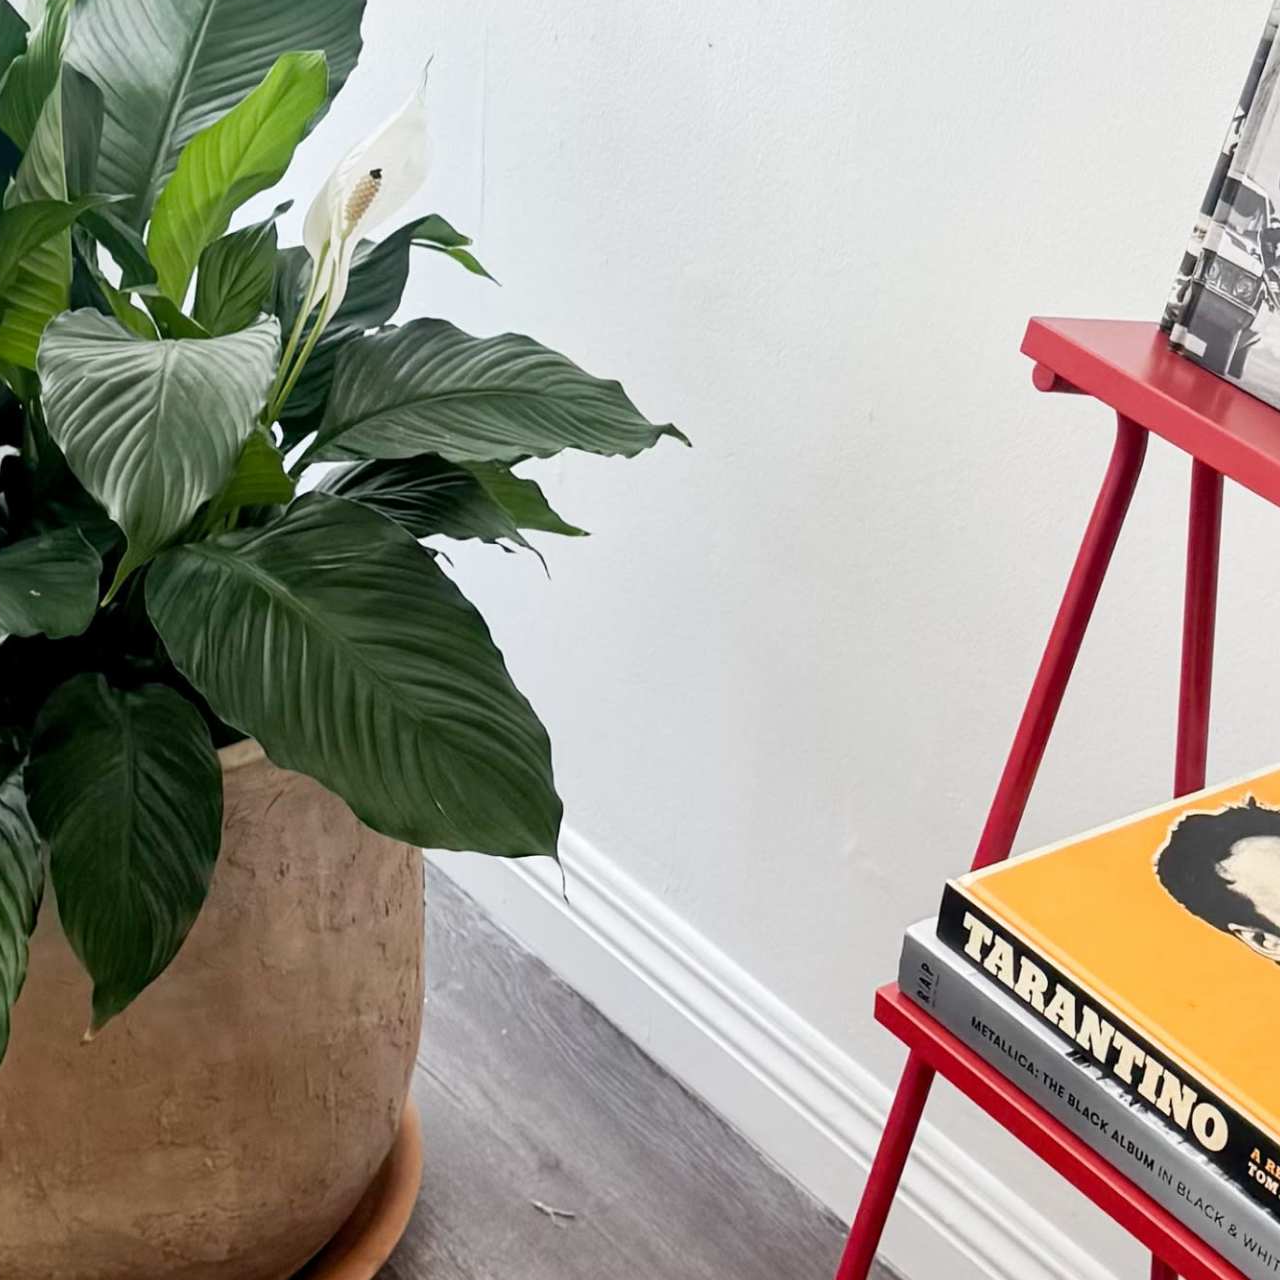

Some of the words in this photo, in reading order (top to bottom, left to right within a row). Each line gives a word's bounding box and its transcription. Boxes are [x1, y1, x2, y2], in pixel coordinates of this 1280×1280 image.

[963, 911, 1229, 1152] TARANTINO
[970, 1016, 1040, 1080] METALLICA:
[1042, 1070, 1066, 1098] THE
[1067, 1092, 1110, 1135] BLACK
[1111, 1128, 1157, 1172] ALBUM
[1157, 1164, 1174, 1186] IN
[1176, 1181, 1224, 1228] BLACK
[1226, 1222, 1238, 1239] &
[1247, 1163, 1279, 1199] TOM
[1250, 1147, 1261, 1166] A
